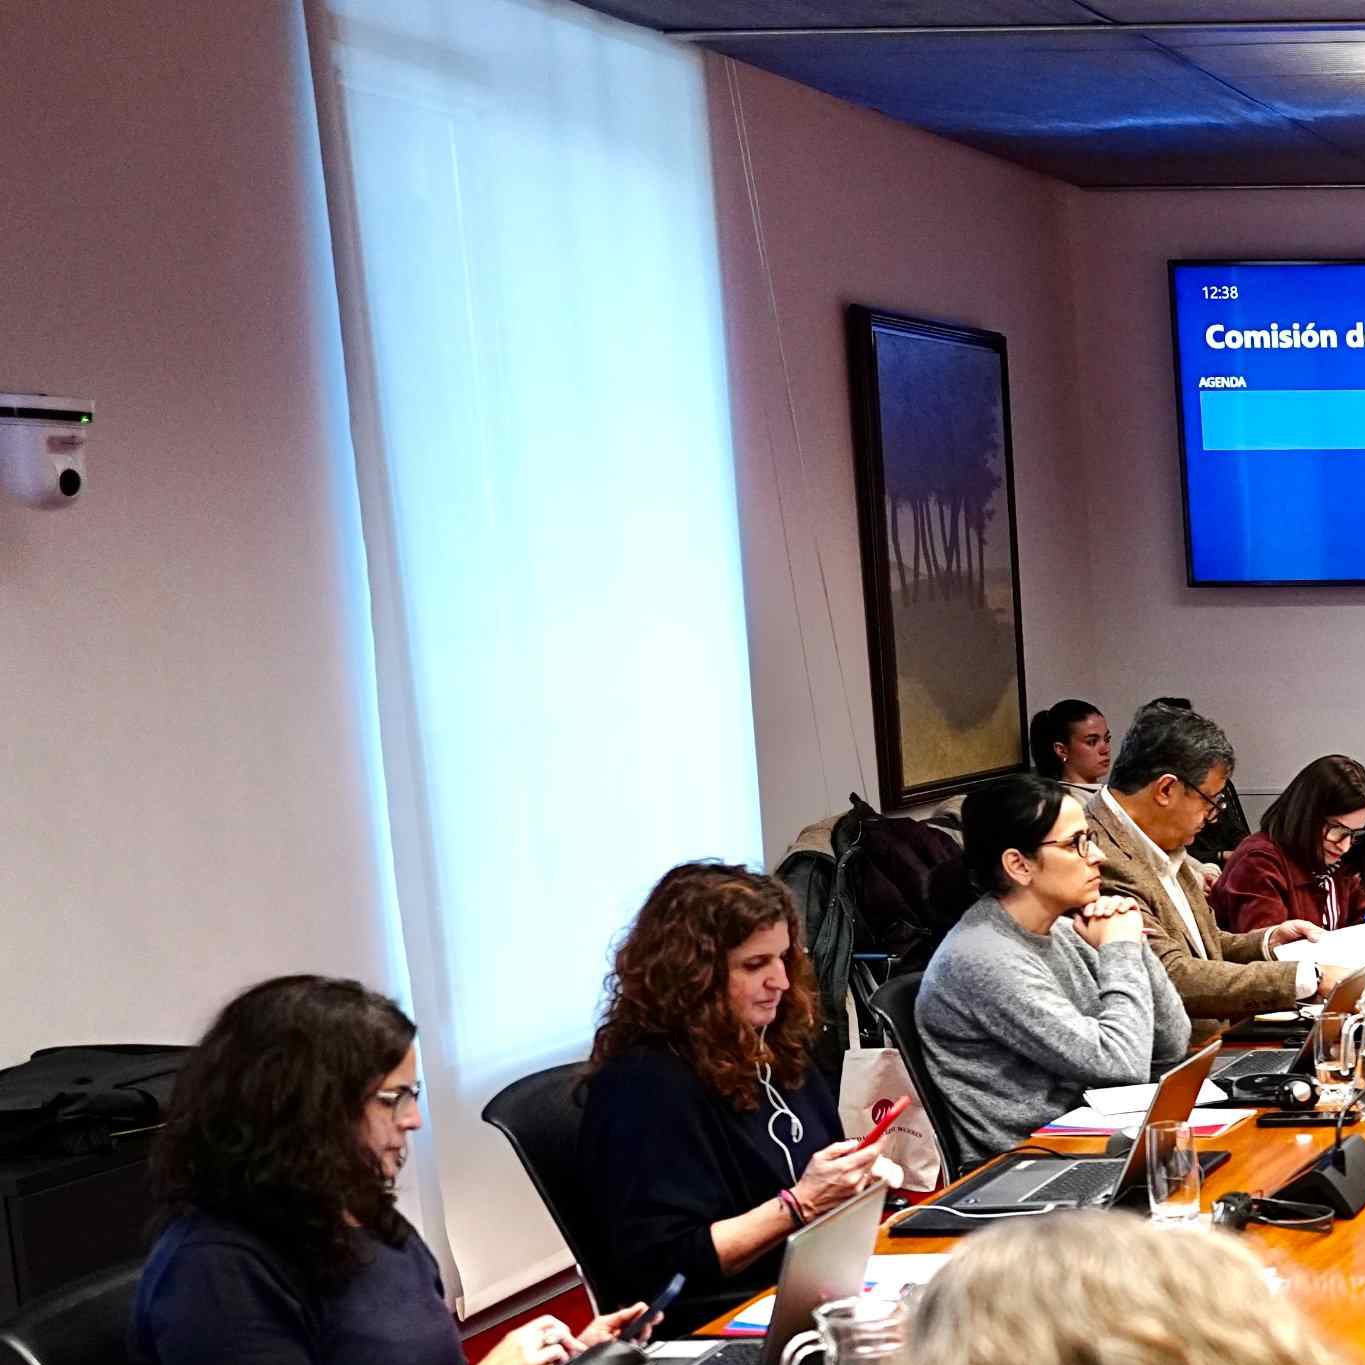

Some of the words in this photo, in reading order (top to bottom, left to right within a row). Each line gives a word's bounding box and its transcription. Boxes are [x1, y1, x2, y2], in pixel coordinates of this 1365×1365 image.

[1202, 285, 1239, 300] 12:38
[1205, 322, 1338, 350] Comisión
[1198, 376, 1248, 389] AGENDA
